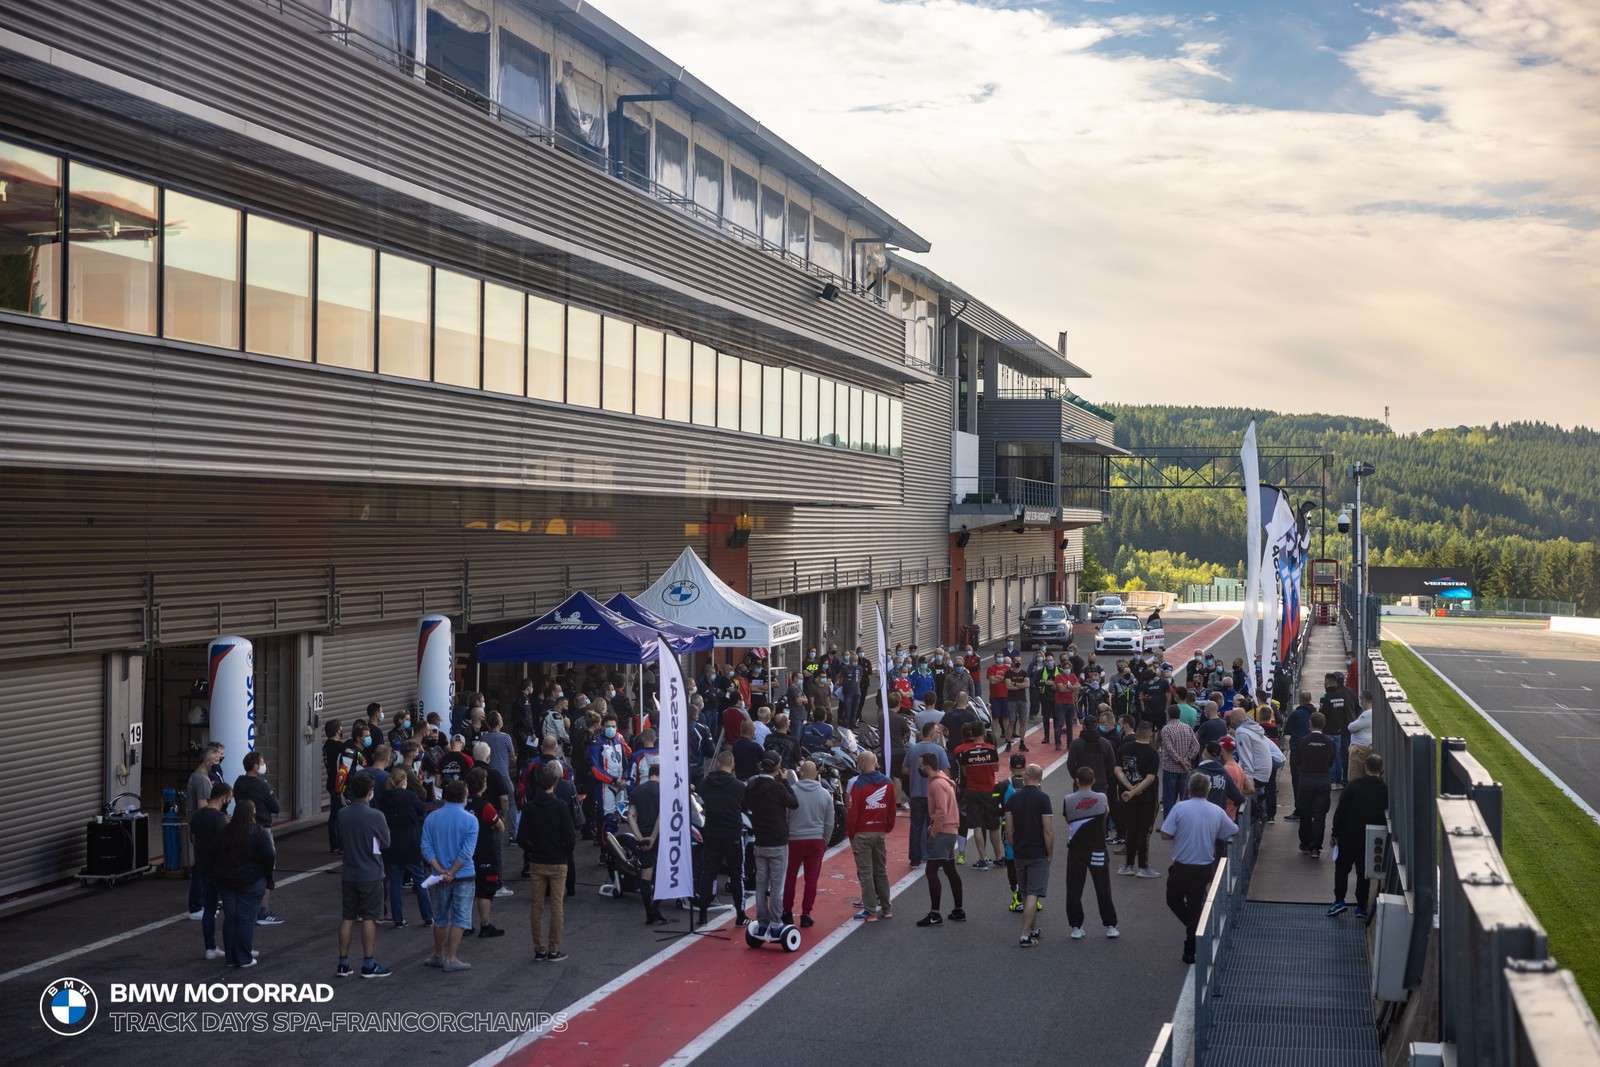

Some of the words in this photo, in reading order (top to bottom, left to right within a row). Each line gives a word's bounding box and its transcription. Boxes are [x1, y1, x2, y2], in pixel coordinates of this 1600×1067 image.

[668, 582, 696, 590] BMW
[806, 664, 820, 672] 46
[314, 693, 323, 709] 18
[130, 725, 142, 743] 19
[967, 754, 992, 763] aruba.it
